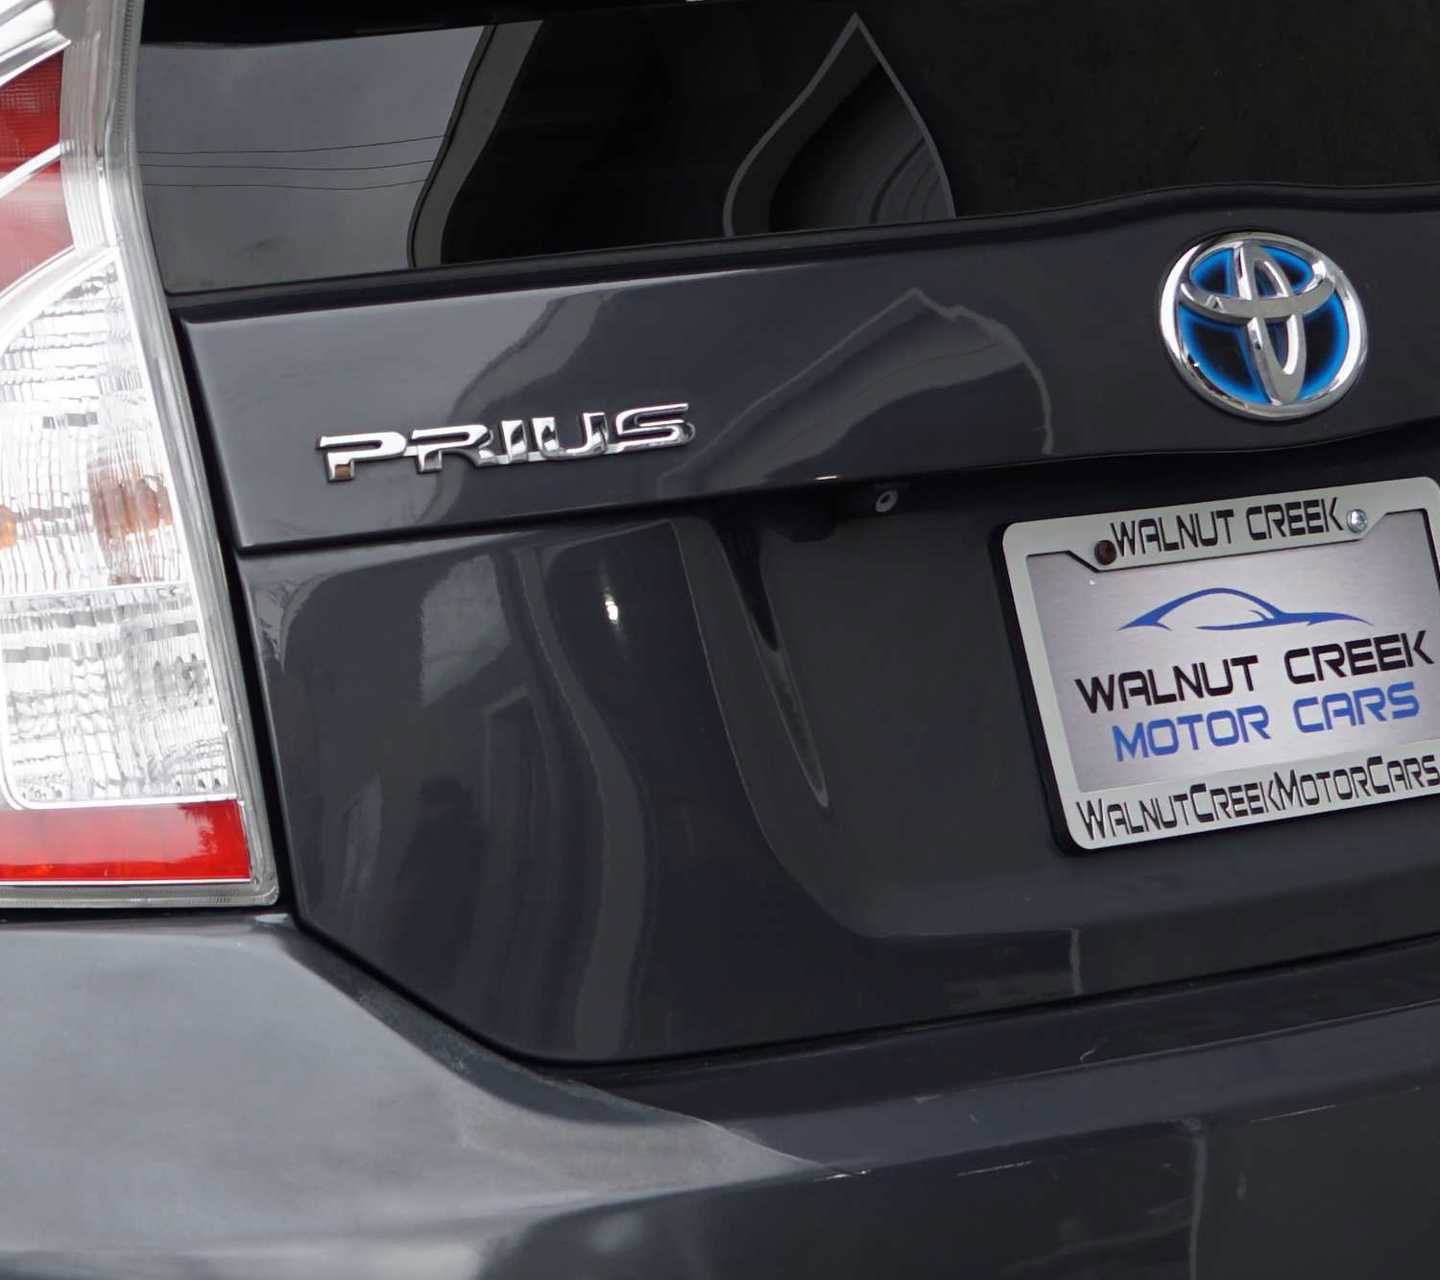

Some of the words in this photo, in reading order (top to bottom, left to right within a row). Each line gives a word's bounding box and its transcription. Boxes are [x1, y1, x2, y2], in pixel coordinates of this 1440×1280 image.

[318, 402, 696, 483] PRIUS
[1110, 509, 1235, 558] WALNUT
[1246, 496, 1343, 541] CREEK
[1074, 655, 1259, 715] WALNUT
[1283, 630, 1435, 685] CREEK
[1111, 705, 1271, 762] MOTOR
[1293, 681, 1420, 734] CARS
